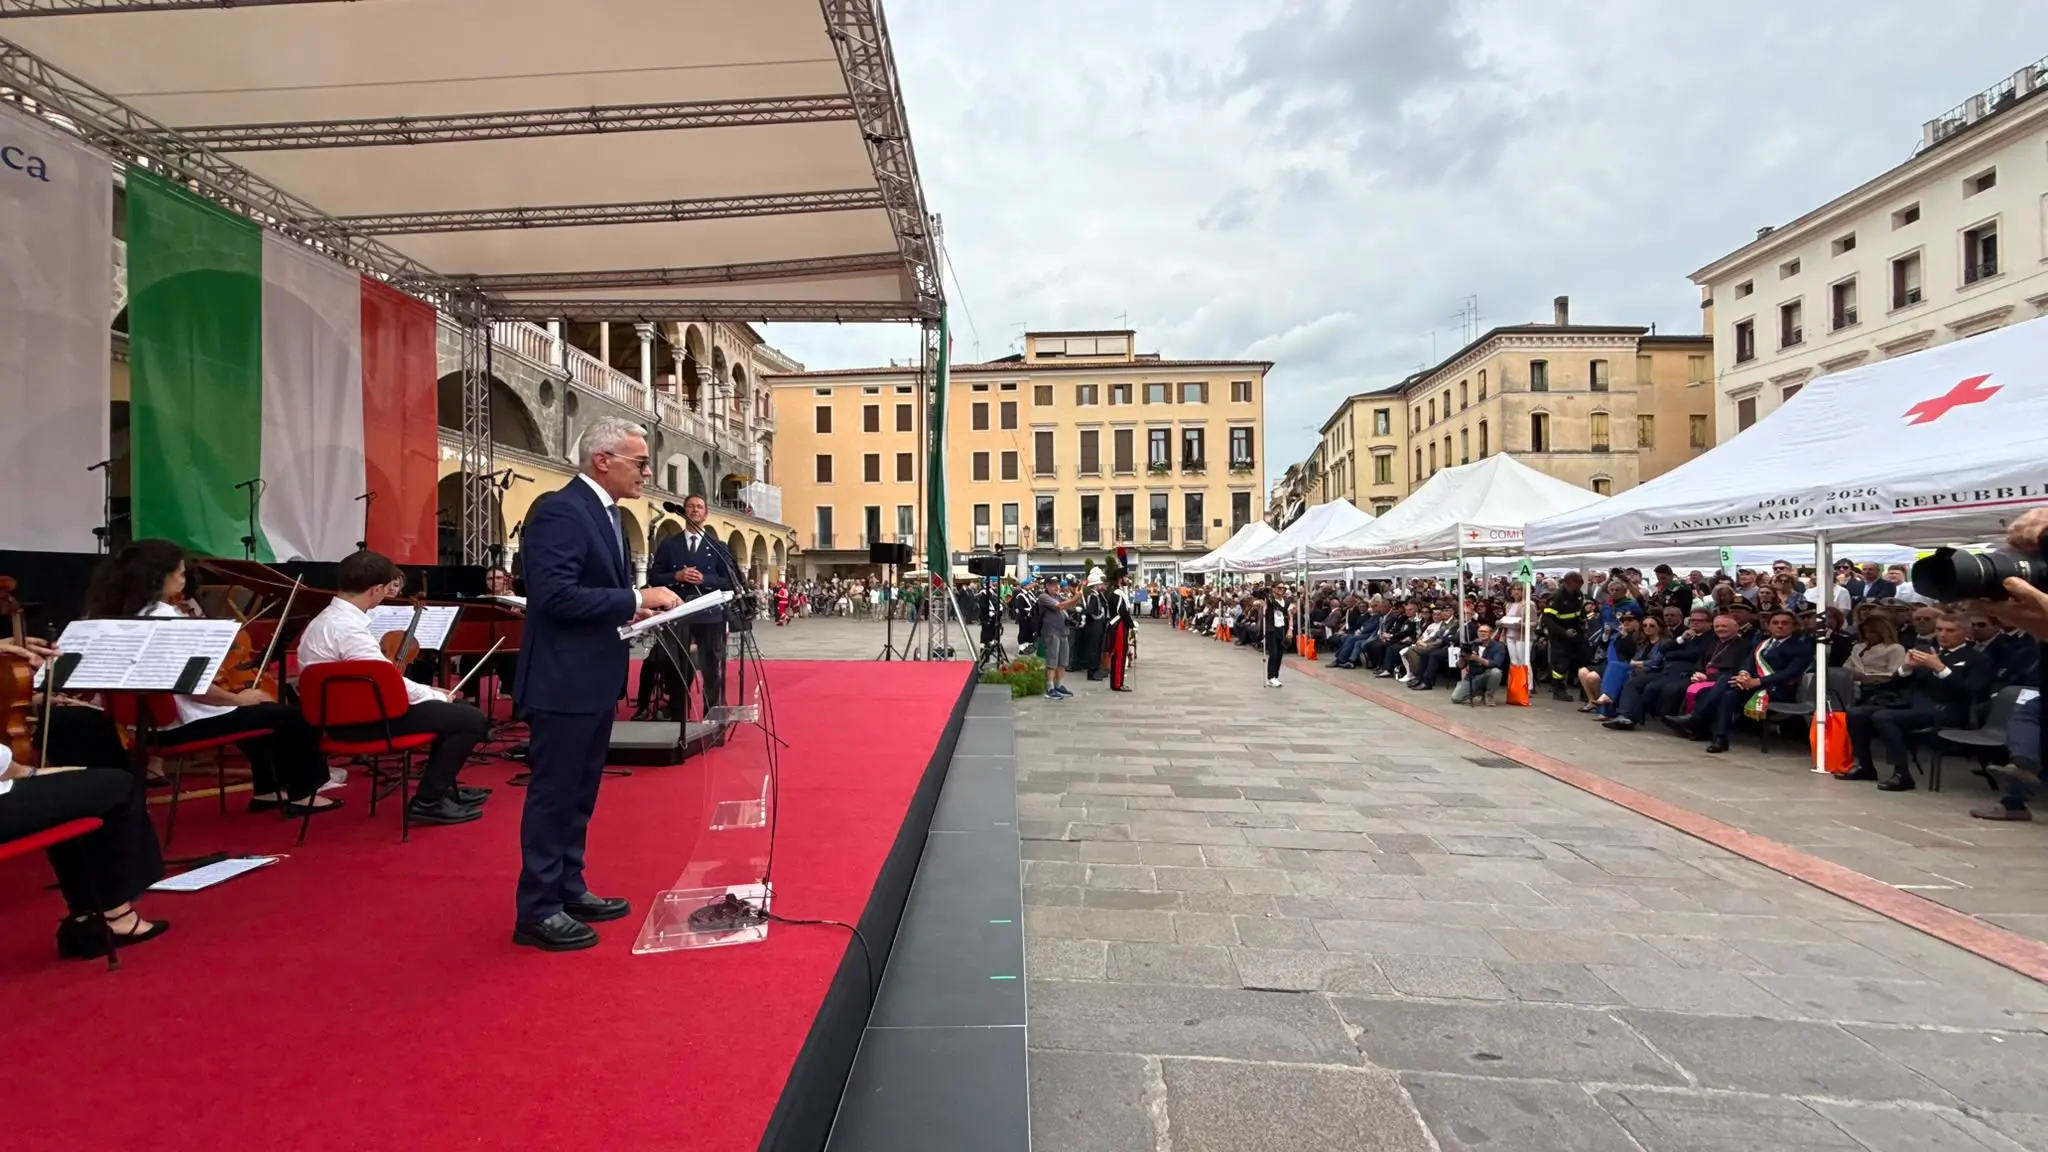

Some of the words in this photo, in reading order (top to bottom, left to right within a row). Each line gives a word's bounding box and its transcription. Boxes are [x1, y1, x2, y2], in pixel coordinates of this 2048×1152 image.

[1, 146, 50, 182] ca
[1758, 496, 1799, 509] 1946
[1826, 487, 1878, 501] 2026
[1671, 507, 1815, 530] ANNIVERSARIO
[1825, 502, 1881, 515] della
[1722, 551, 1729, 561] B
[1520, 564, 1531, 577] A
